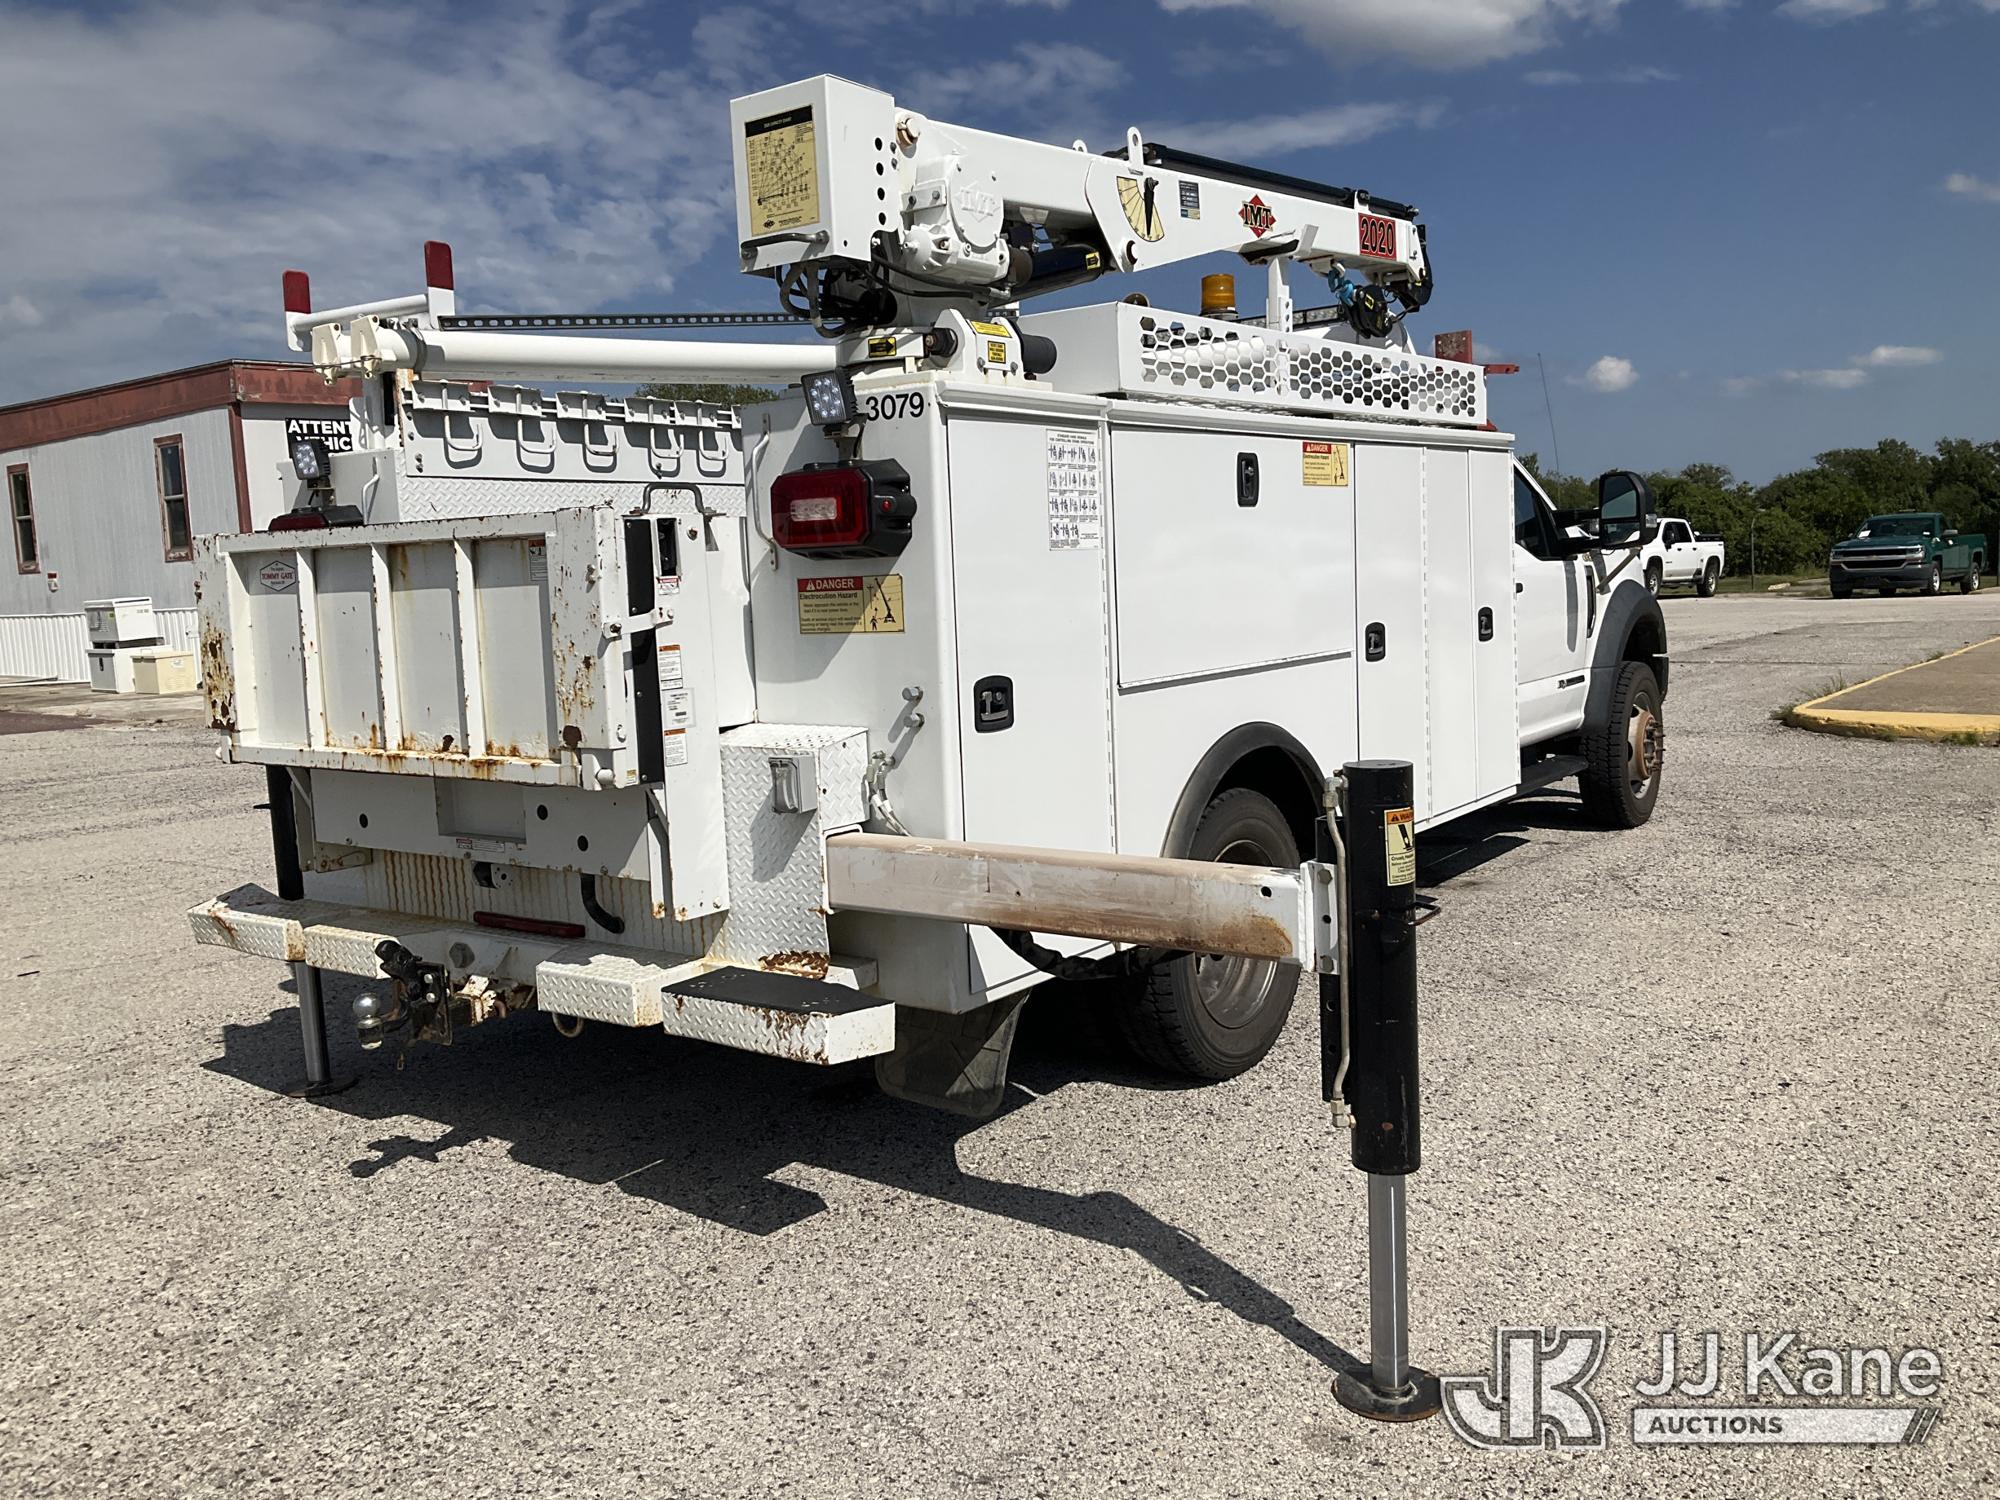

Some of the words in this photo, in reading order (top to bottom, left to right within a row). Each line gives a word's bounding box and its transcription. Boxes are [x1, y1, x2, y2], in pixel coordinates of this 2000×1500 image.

[1242, 202, 1272, 230] IMT
[1361, 217, 1394, 256] 2020
[865, 391, 925, 421] 3079
[816, 579, 854, 589] DANGER
